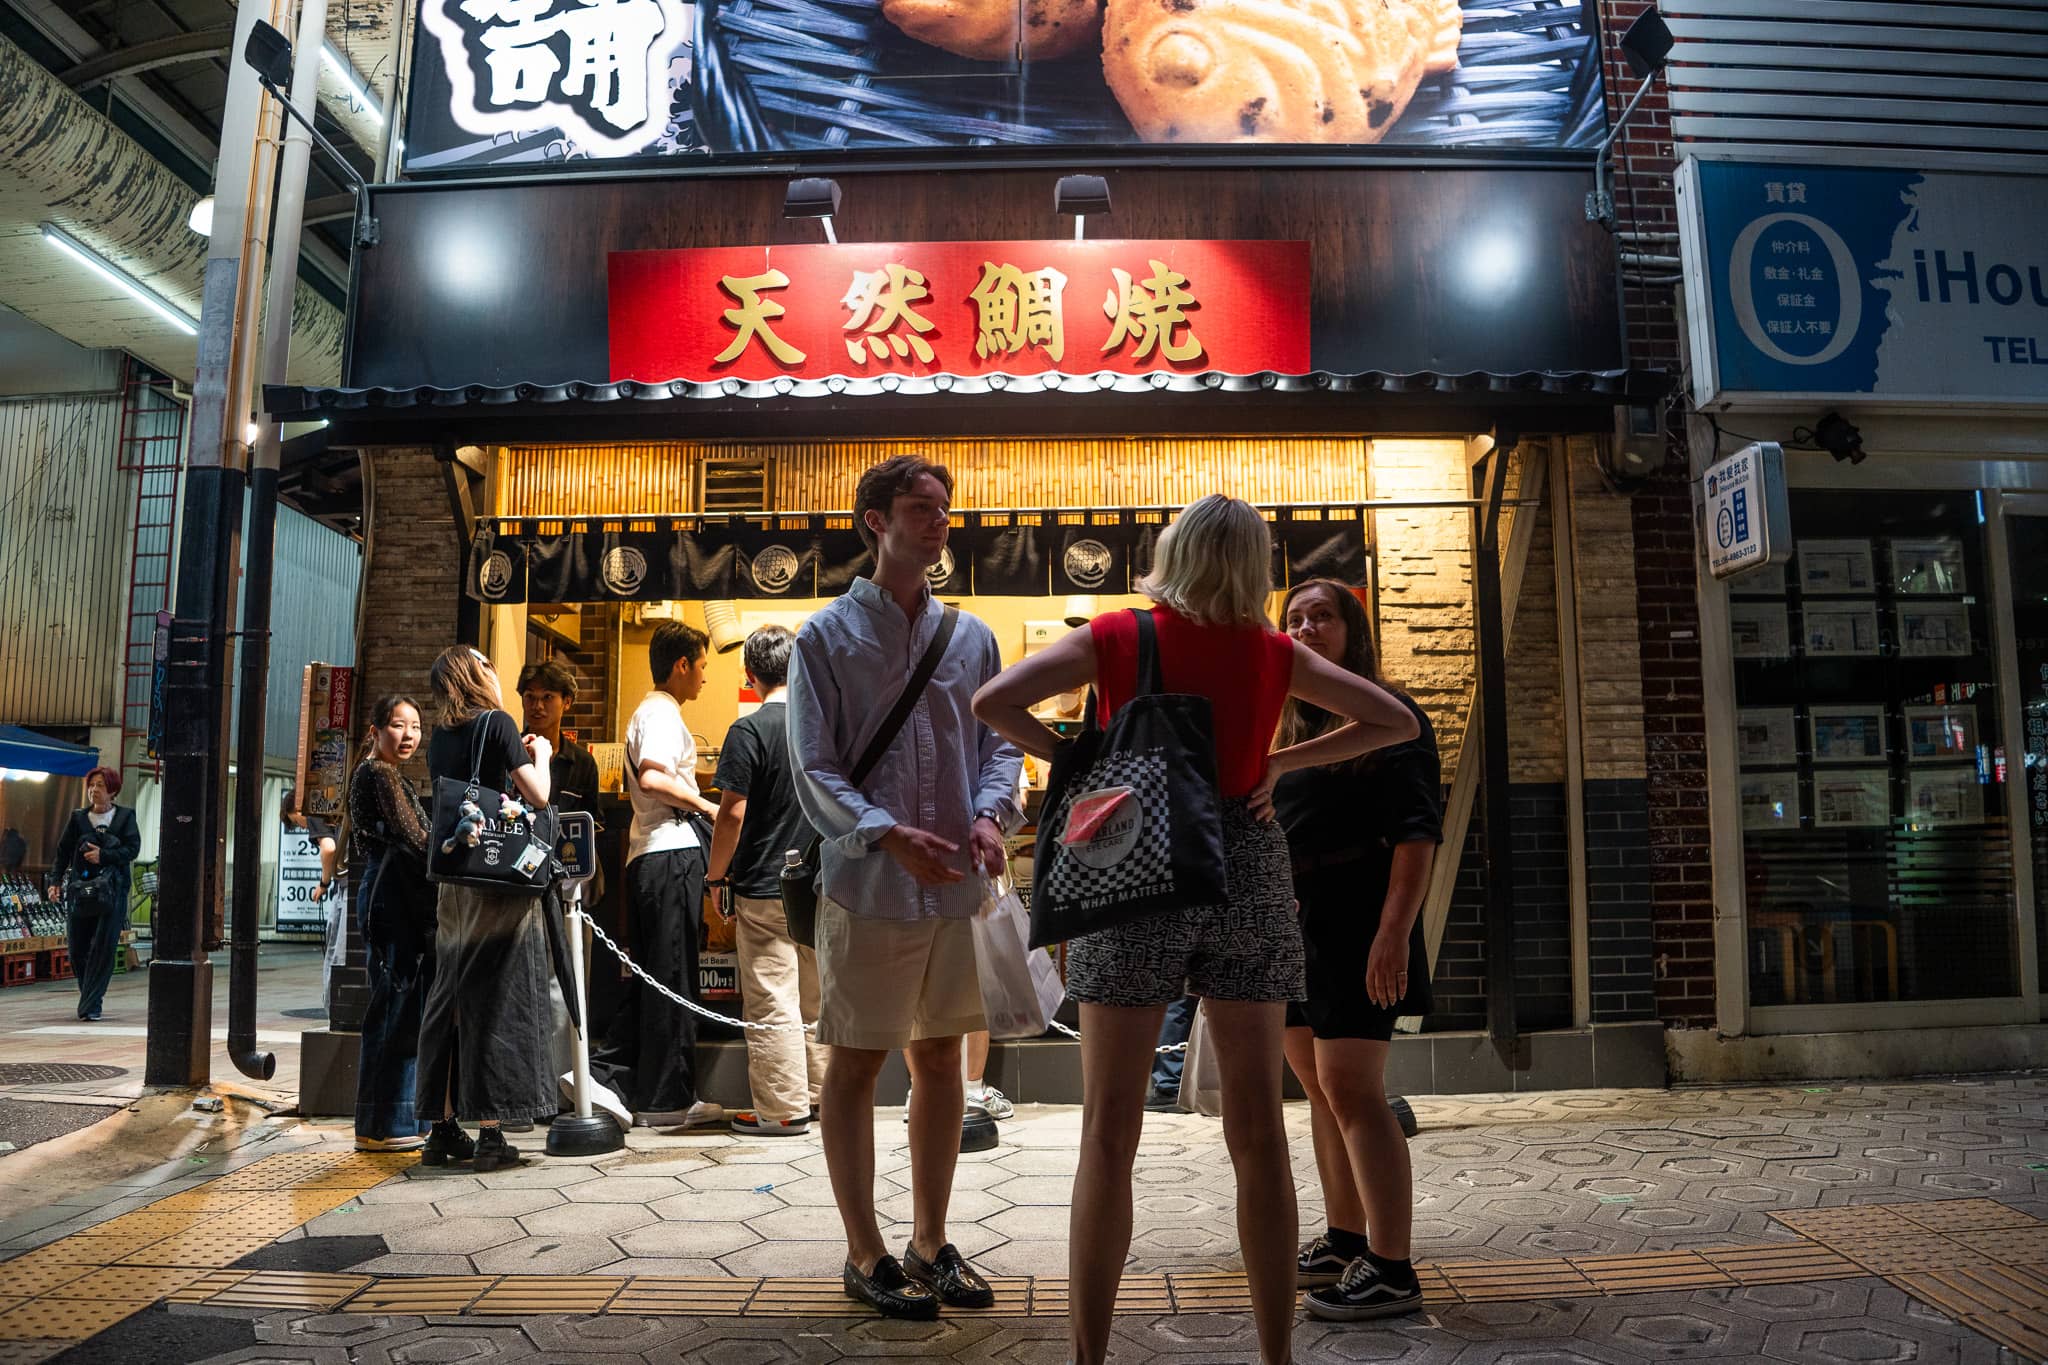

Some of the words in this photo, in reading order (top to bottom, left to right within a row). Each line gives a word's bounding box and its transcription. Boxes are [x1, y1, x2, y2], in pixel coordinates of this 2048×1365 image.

[1764, 182, 1807, 204] 賃貸
[713, 259, 1203, 365] 天然鯛焼
[1777, 294, 1816, 308] 保証金
[1767, 320, 1832, 335] 保証人不要
[332, 670, 348, 727] 火災受信所
[1081, 895, 1114, 911] WHAT
[1118, 882, 1175, 903] MATTERS
[711, 957, 729, 965] Bean
